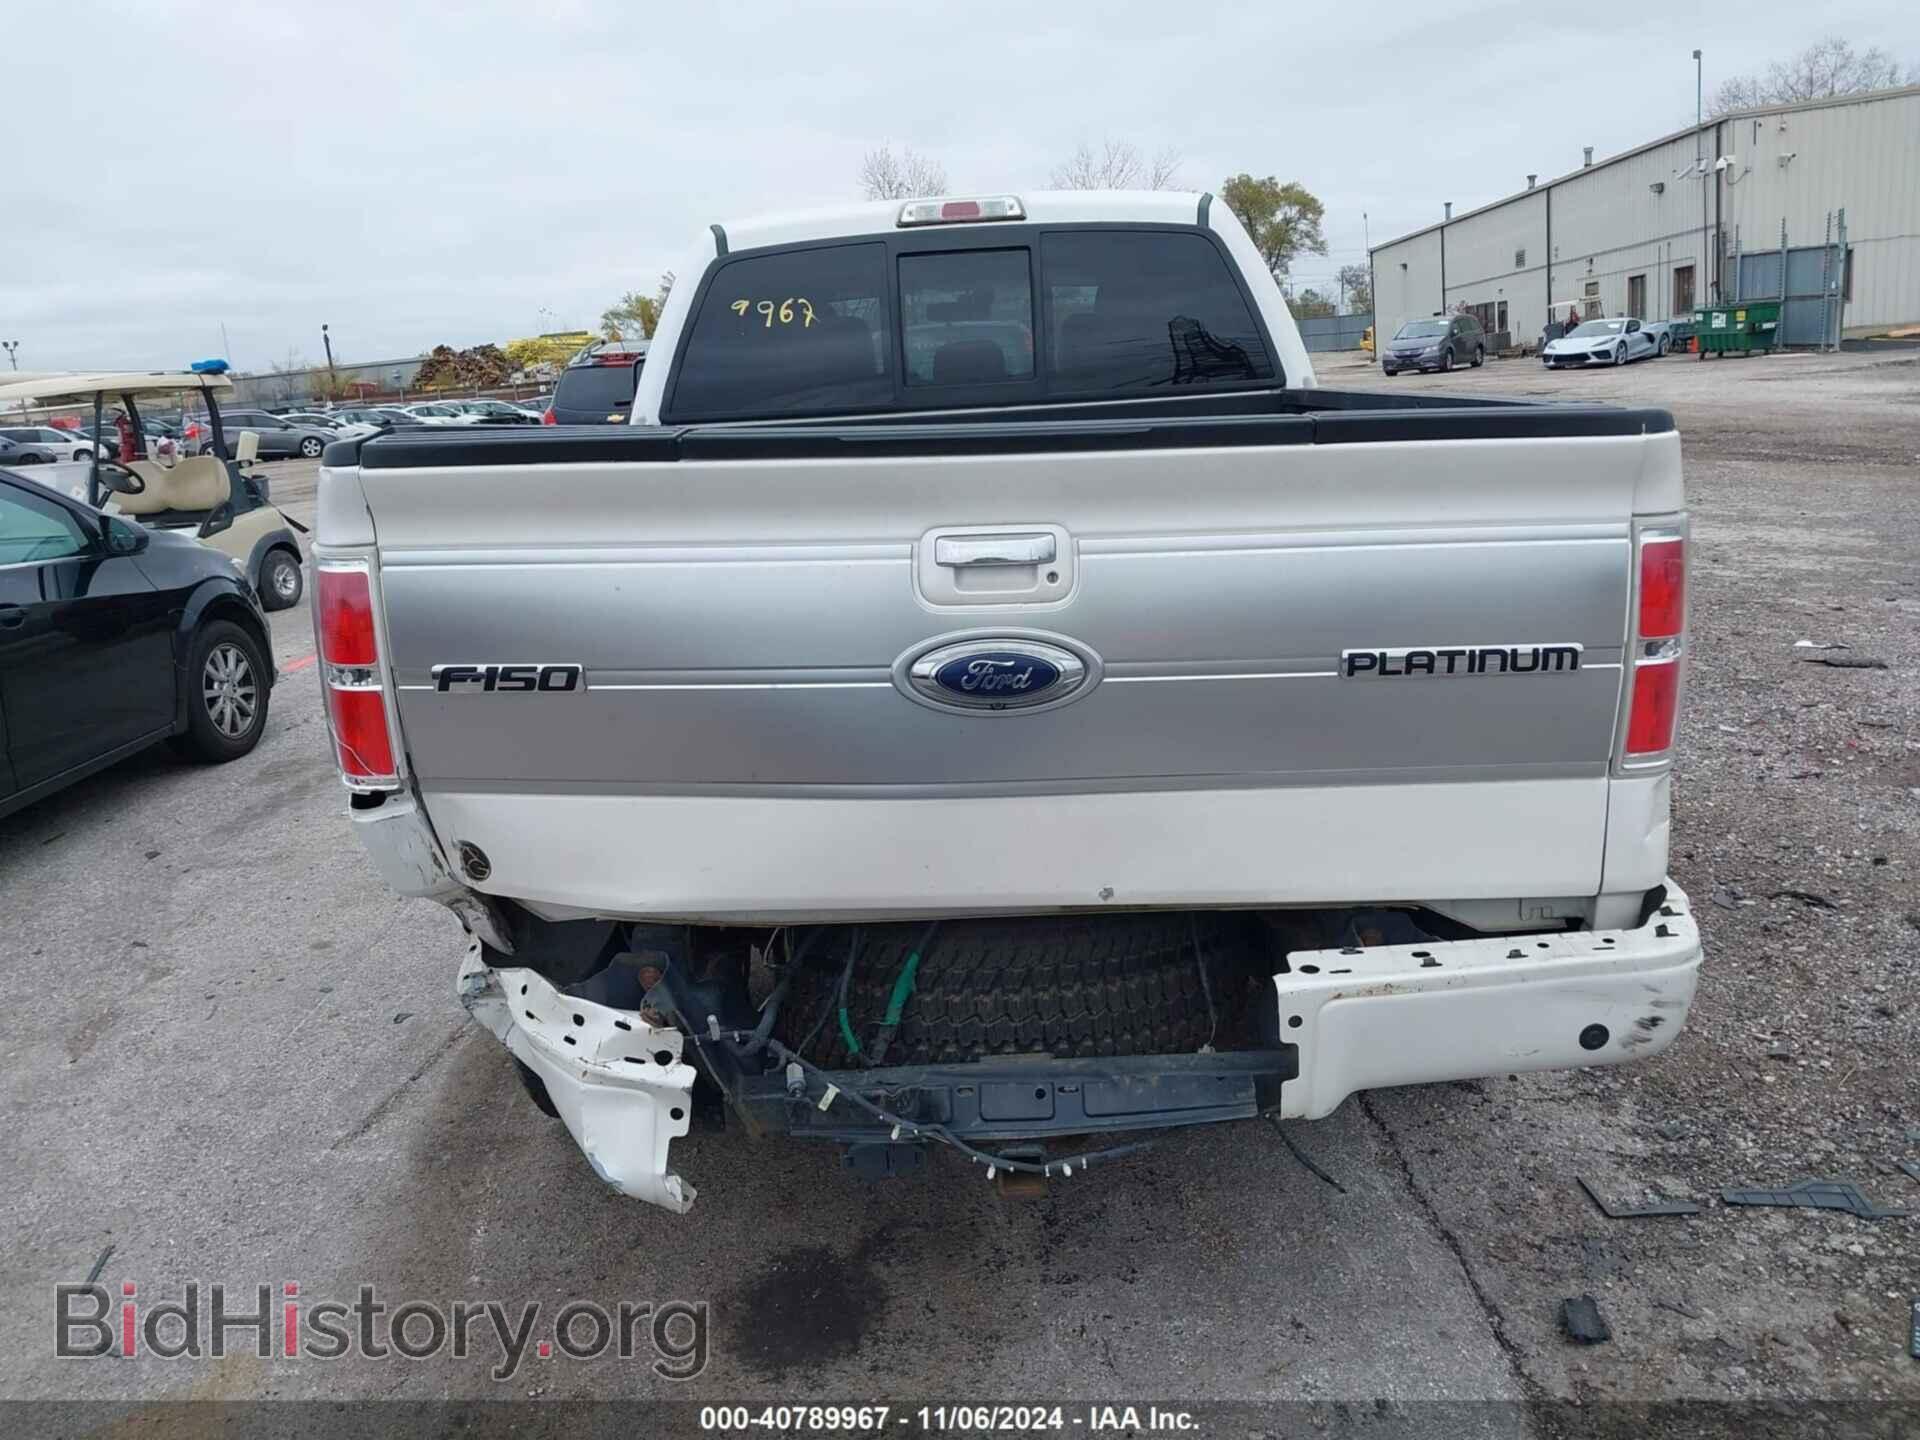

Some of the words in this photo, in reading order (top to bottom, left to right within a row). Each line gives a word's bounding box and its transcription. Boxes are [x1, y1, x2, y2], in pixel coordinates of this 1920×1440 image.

[961, 659, 1032, 690] Ford
[1345, 646, 1580, 678] PLATINUM
[435, 664, 582, 692] F-150
